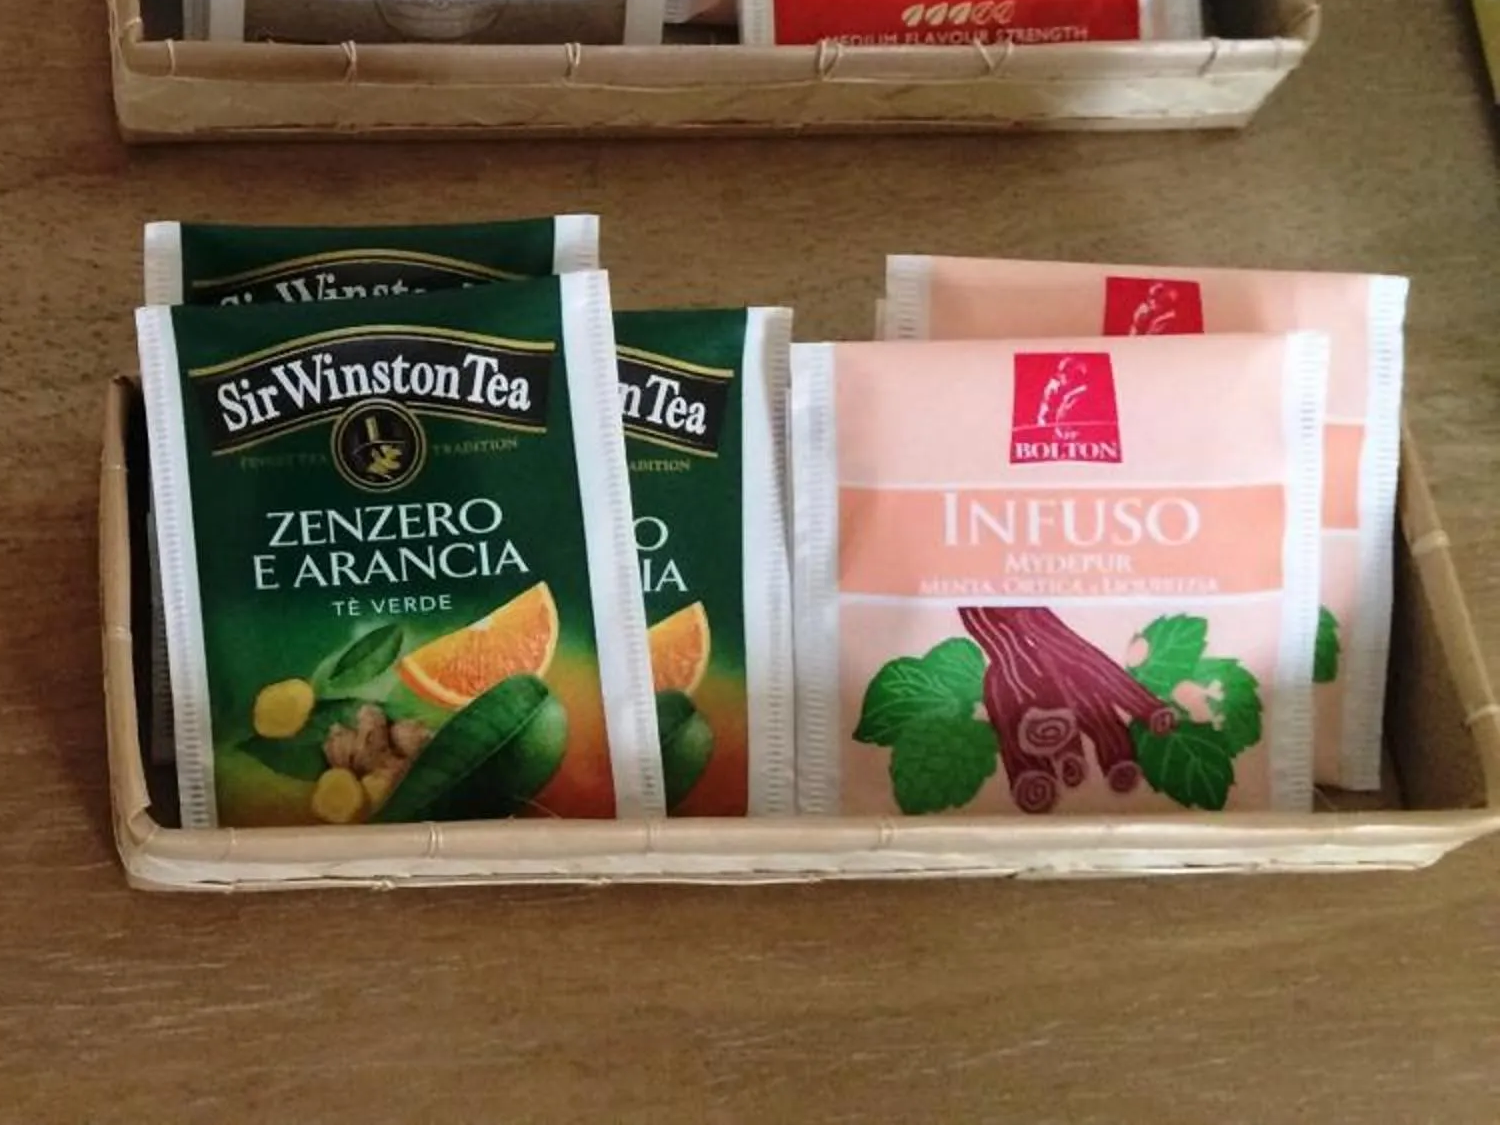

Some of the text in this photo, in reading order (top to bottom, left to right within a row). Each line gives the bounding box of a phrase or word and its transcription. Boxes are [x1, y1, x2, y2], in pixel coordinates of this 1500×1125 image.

[216, 352, 532, 432] Sir Winston Tea
[645, 374, 707, 435] Tea
[431, 437, 519, 456] TRADITION
[630, 458, 692, 473] ADITION
[1014, 441, 1119, 460] BOLTON
[265, 497, 503, 548] ZENZERO
[942, 489, 1202, 548] INFUSO
[253, 538, 530, 591] E ARANCIA
[331, 593, 454, 617] TÈ VERDE
